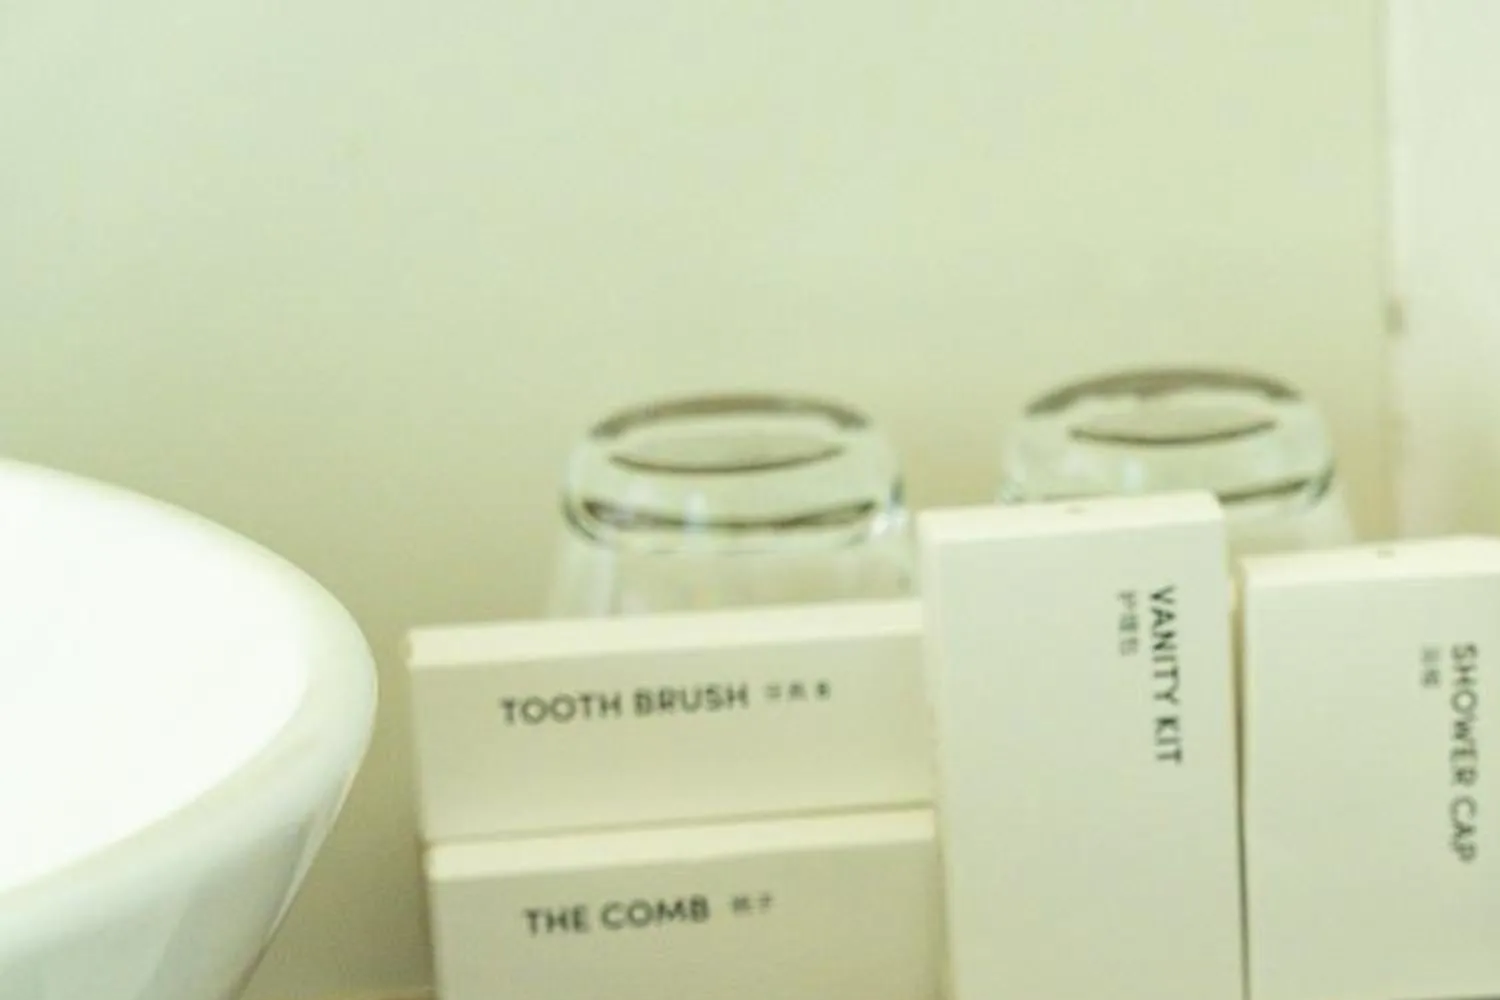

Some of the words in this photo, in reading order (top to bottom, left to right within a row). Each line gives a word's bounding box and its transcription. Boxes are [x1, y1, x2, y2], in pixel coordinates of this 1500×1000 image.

[1150, 584, 1180, 706] VANITY
[500, 692, 623, 727] TOOTH
[633, 681, 748, 719] BRUSH
[1449, 642, 1479, 787] SHOWER
[1155, 714, 1182, 766] KIT
[1449, 794, 1478, 865] CAP
[523, 904, 590, 938] THE
[601, 894, 710, 930] COMB
